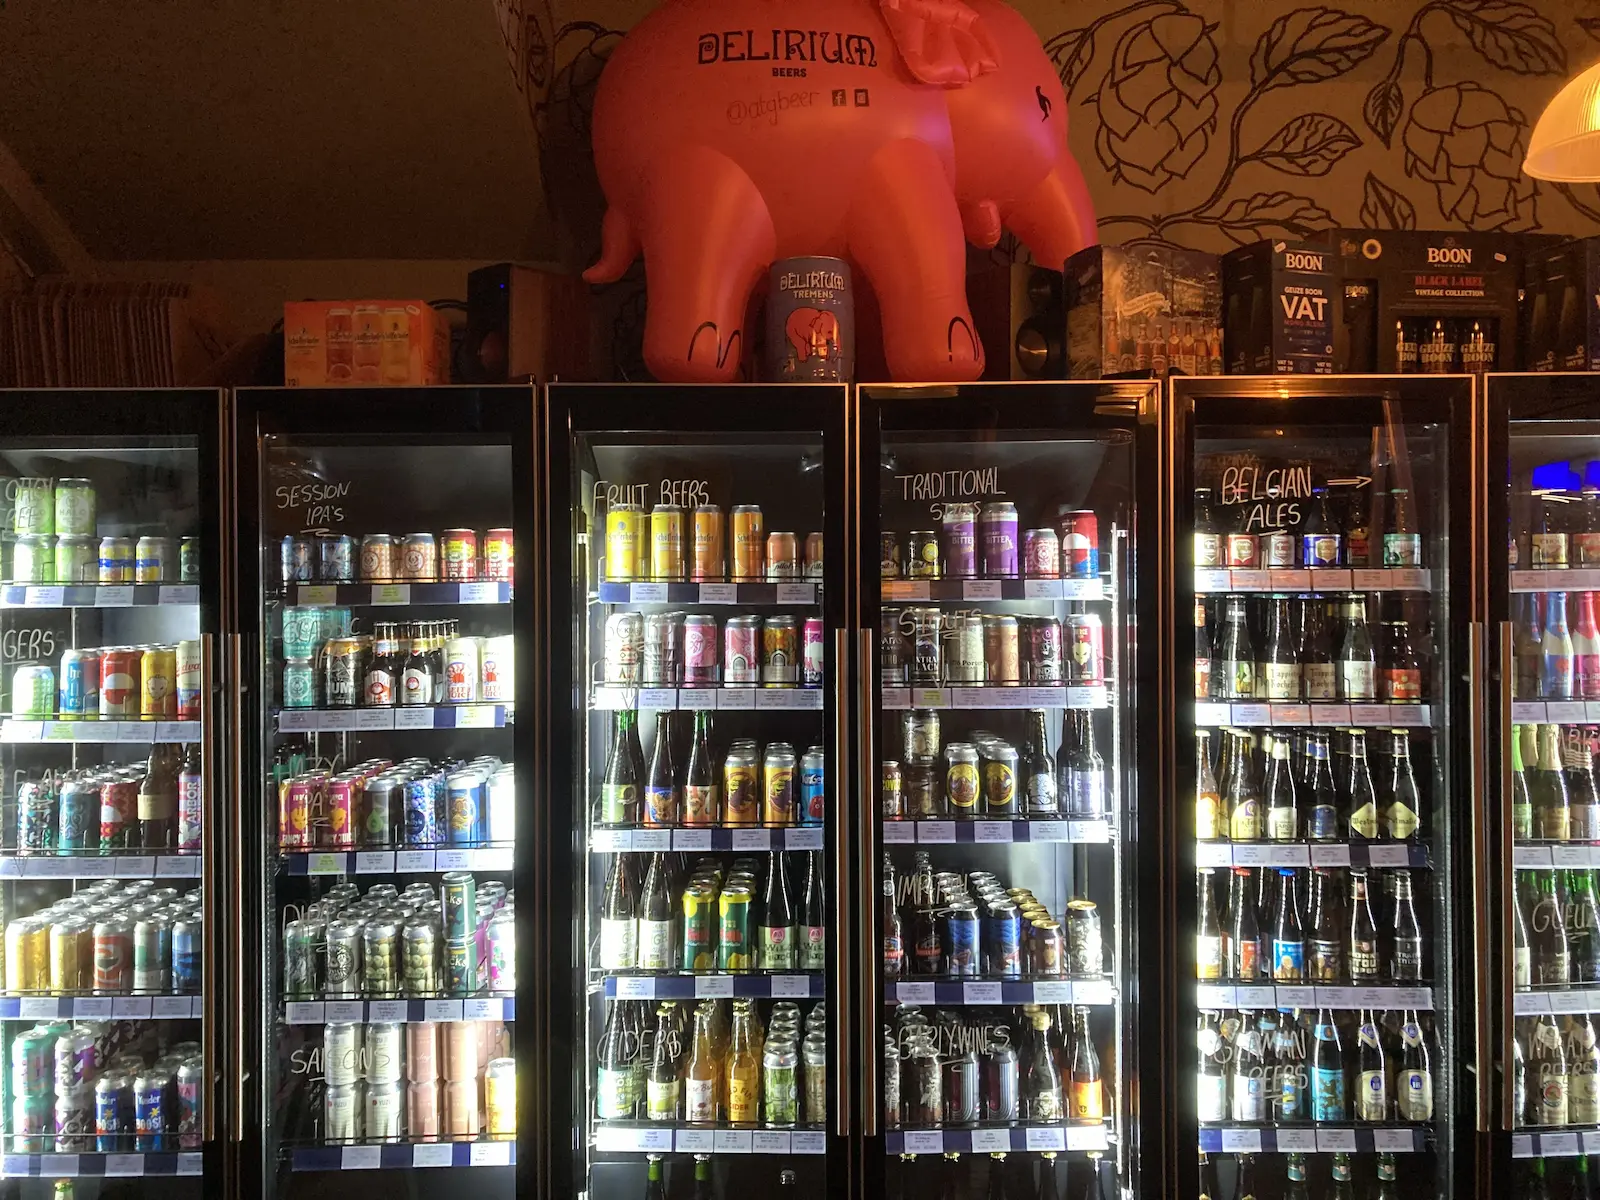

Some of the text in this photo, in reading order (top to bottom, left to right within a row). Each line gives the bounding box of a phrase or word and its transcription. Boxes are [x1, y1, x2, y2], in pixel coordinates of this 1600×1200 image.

[698, 29, 877, 67] DELIRIUM
[772, 67, 807, 77] BEERS
[1285, 253, 1323, 270] BOON
[1427, 247, 1472, 264] BOON
[780, 271, 845, 290] DELIRIUM
[1415, 275, 1485, 287] BLACK LABEL
[793, 290, 834, 298] TREMENS
[1415, 289, 1485, 297] VINTAGE COLLECTION
[1280, 294, 1328, 321] VAT
[1420, 343, 1455, 353] GEUZE
[1461, 343, 1495, 353] GEUZE
[1421, 353, 1453, 363] BOON
[1463, 353, 1493, 363] BOON
[895, 467, 1006, 500] TRADITIONAL
[1221, 466, 1312, 505] BELGIAN
[276, 480, 351, 509] SESSION
[592, 478, 710, 517] FRUIT BEERS
[1246, 503, 1301, 532] ALES
[187, 781, 199, 824] ARBOR
[291, 1047, 390, 1075] SAISONS
